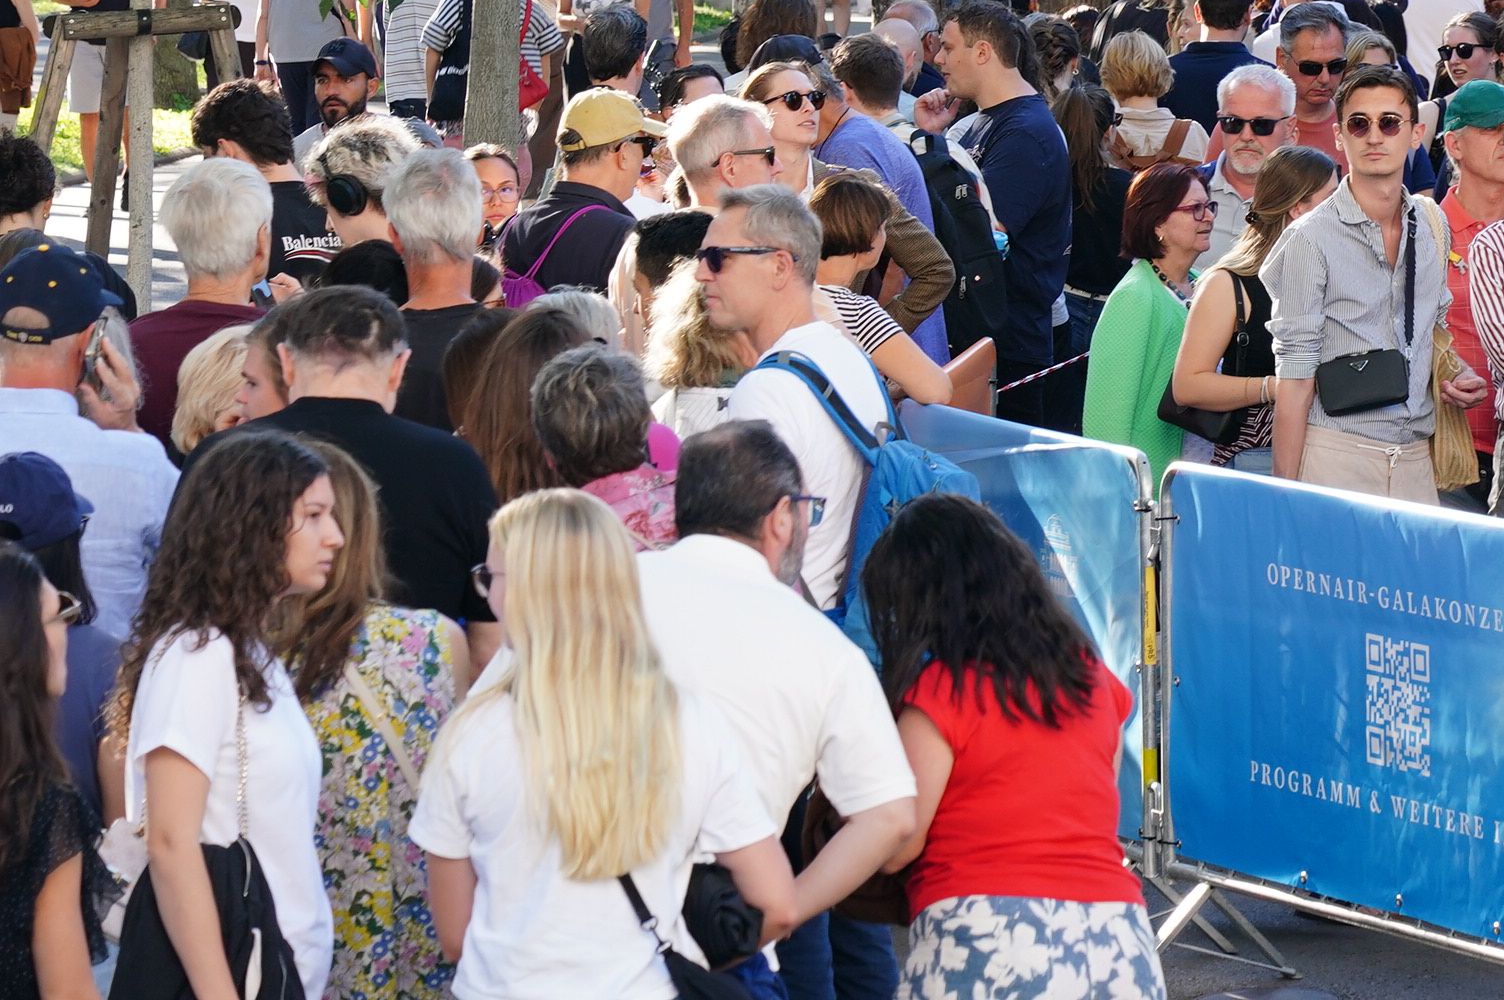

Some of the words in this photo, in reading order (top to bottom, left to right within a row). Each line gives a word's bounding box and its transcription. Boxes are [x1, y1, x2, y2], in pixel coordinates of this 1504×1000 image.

[1250, 760, 1361, 809] PROGRAMM
[1369, 790, 1382, 814] &
[1390, 795, 1484, 840] WEITERE
